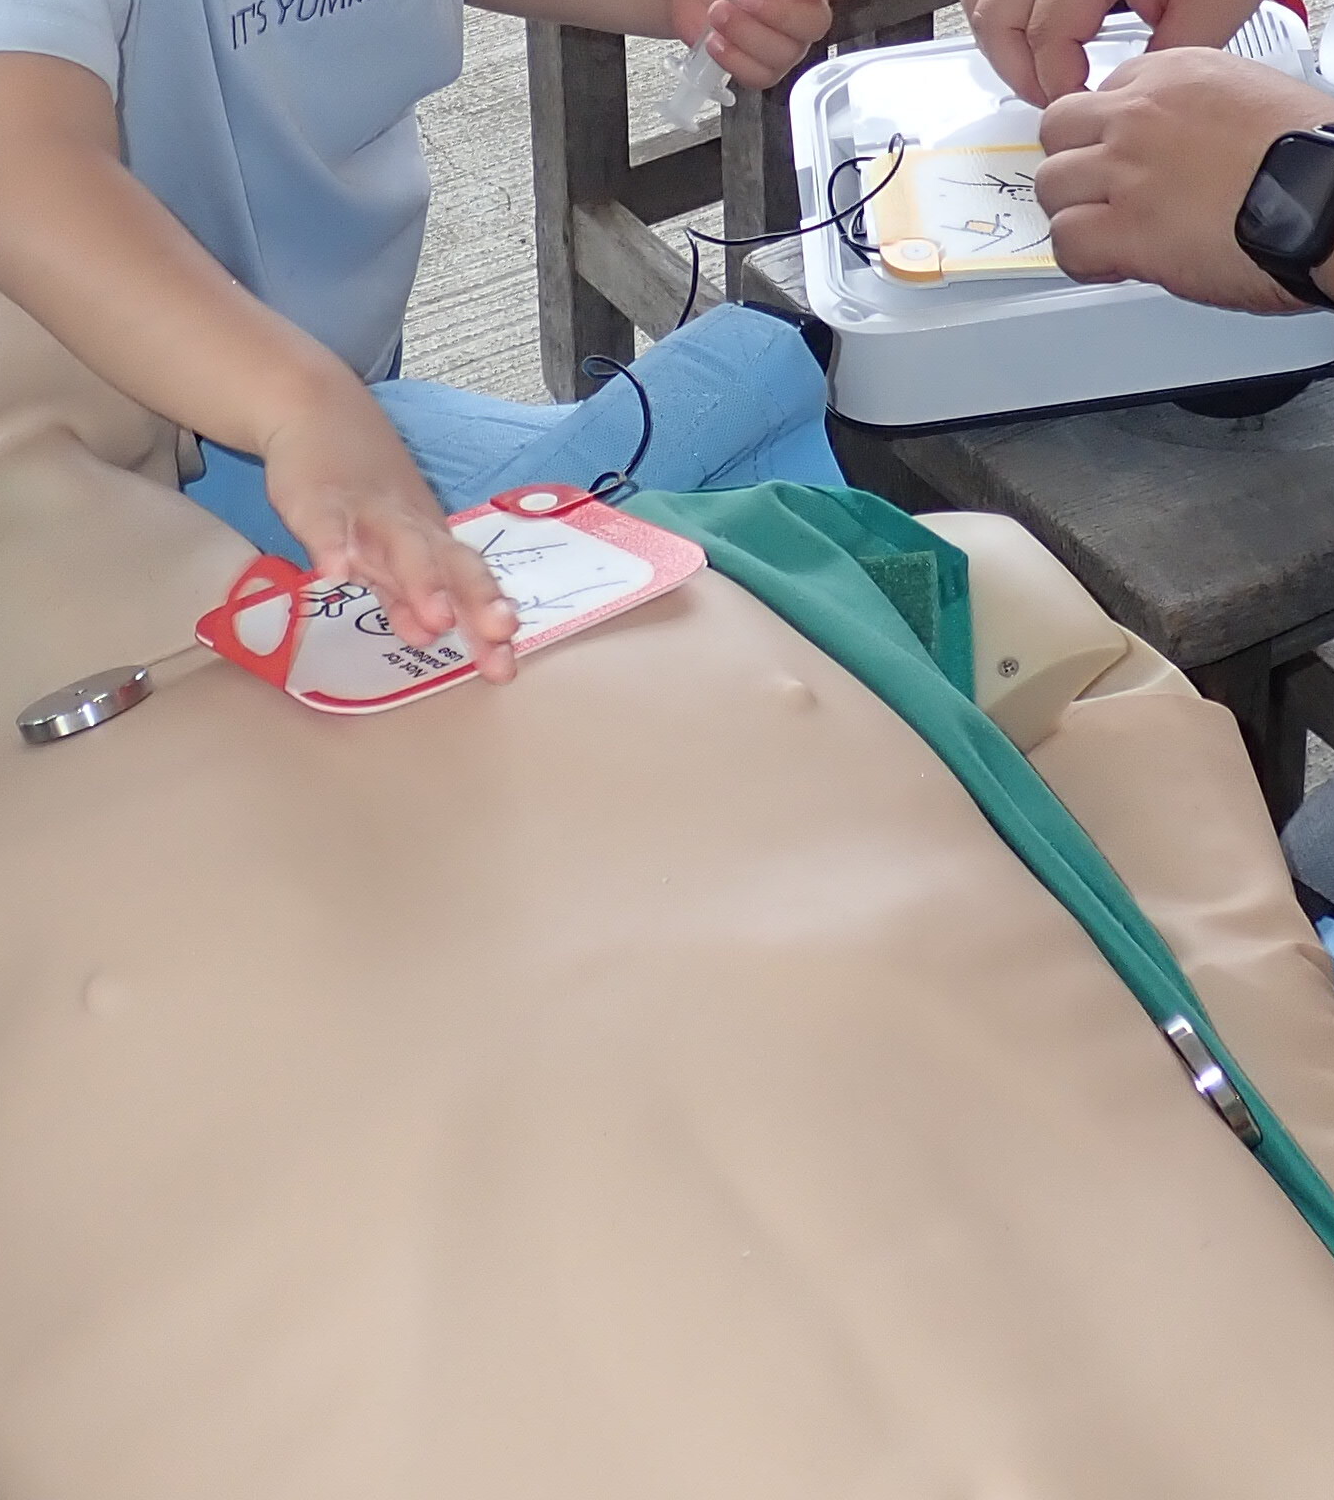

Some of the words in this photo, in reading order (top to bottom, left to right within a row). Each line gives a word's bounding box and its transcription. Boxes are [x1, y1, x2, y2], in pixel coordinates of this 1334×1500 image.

[230, 0, 268, 50] IT'S
[382, 652, 405, 666] for
[438, 647, 464, 662] use
[398, 661, 428, 678] Not
